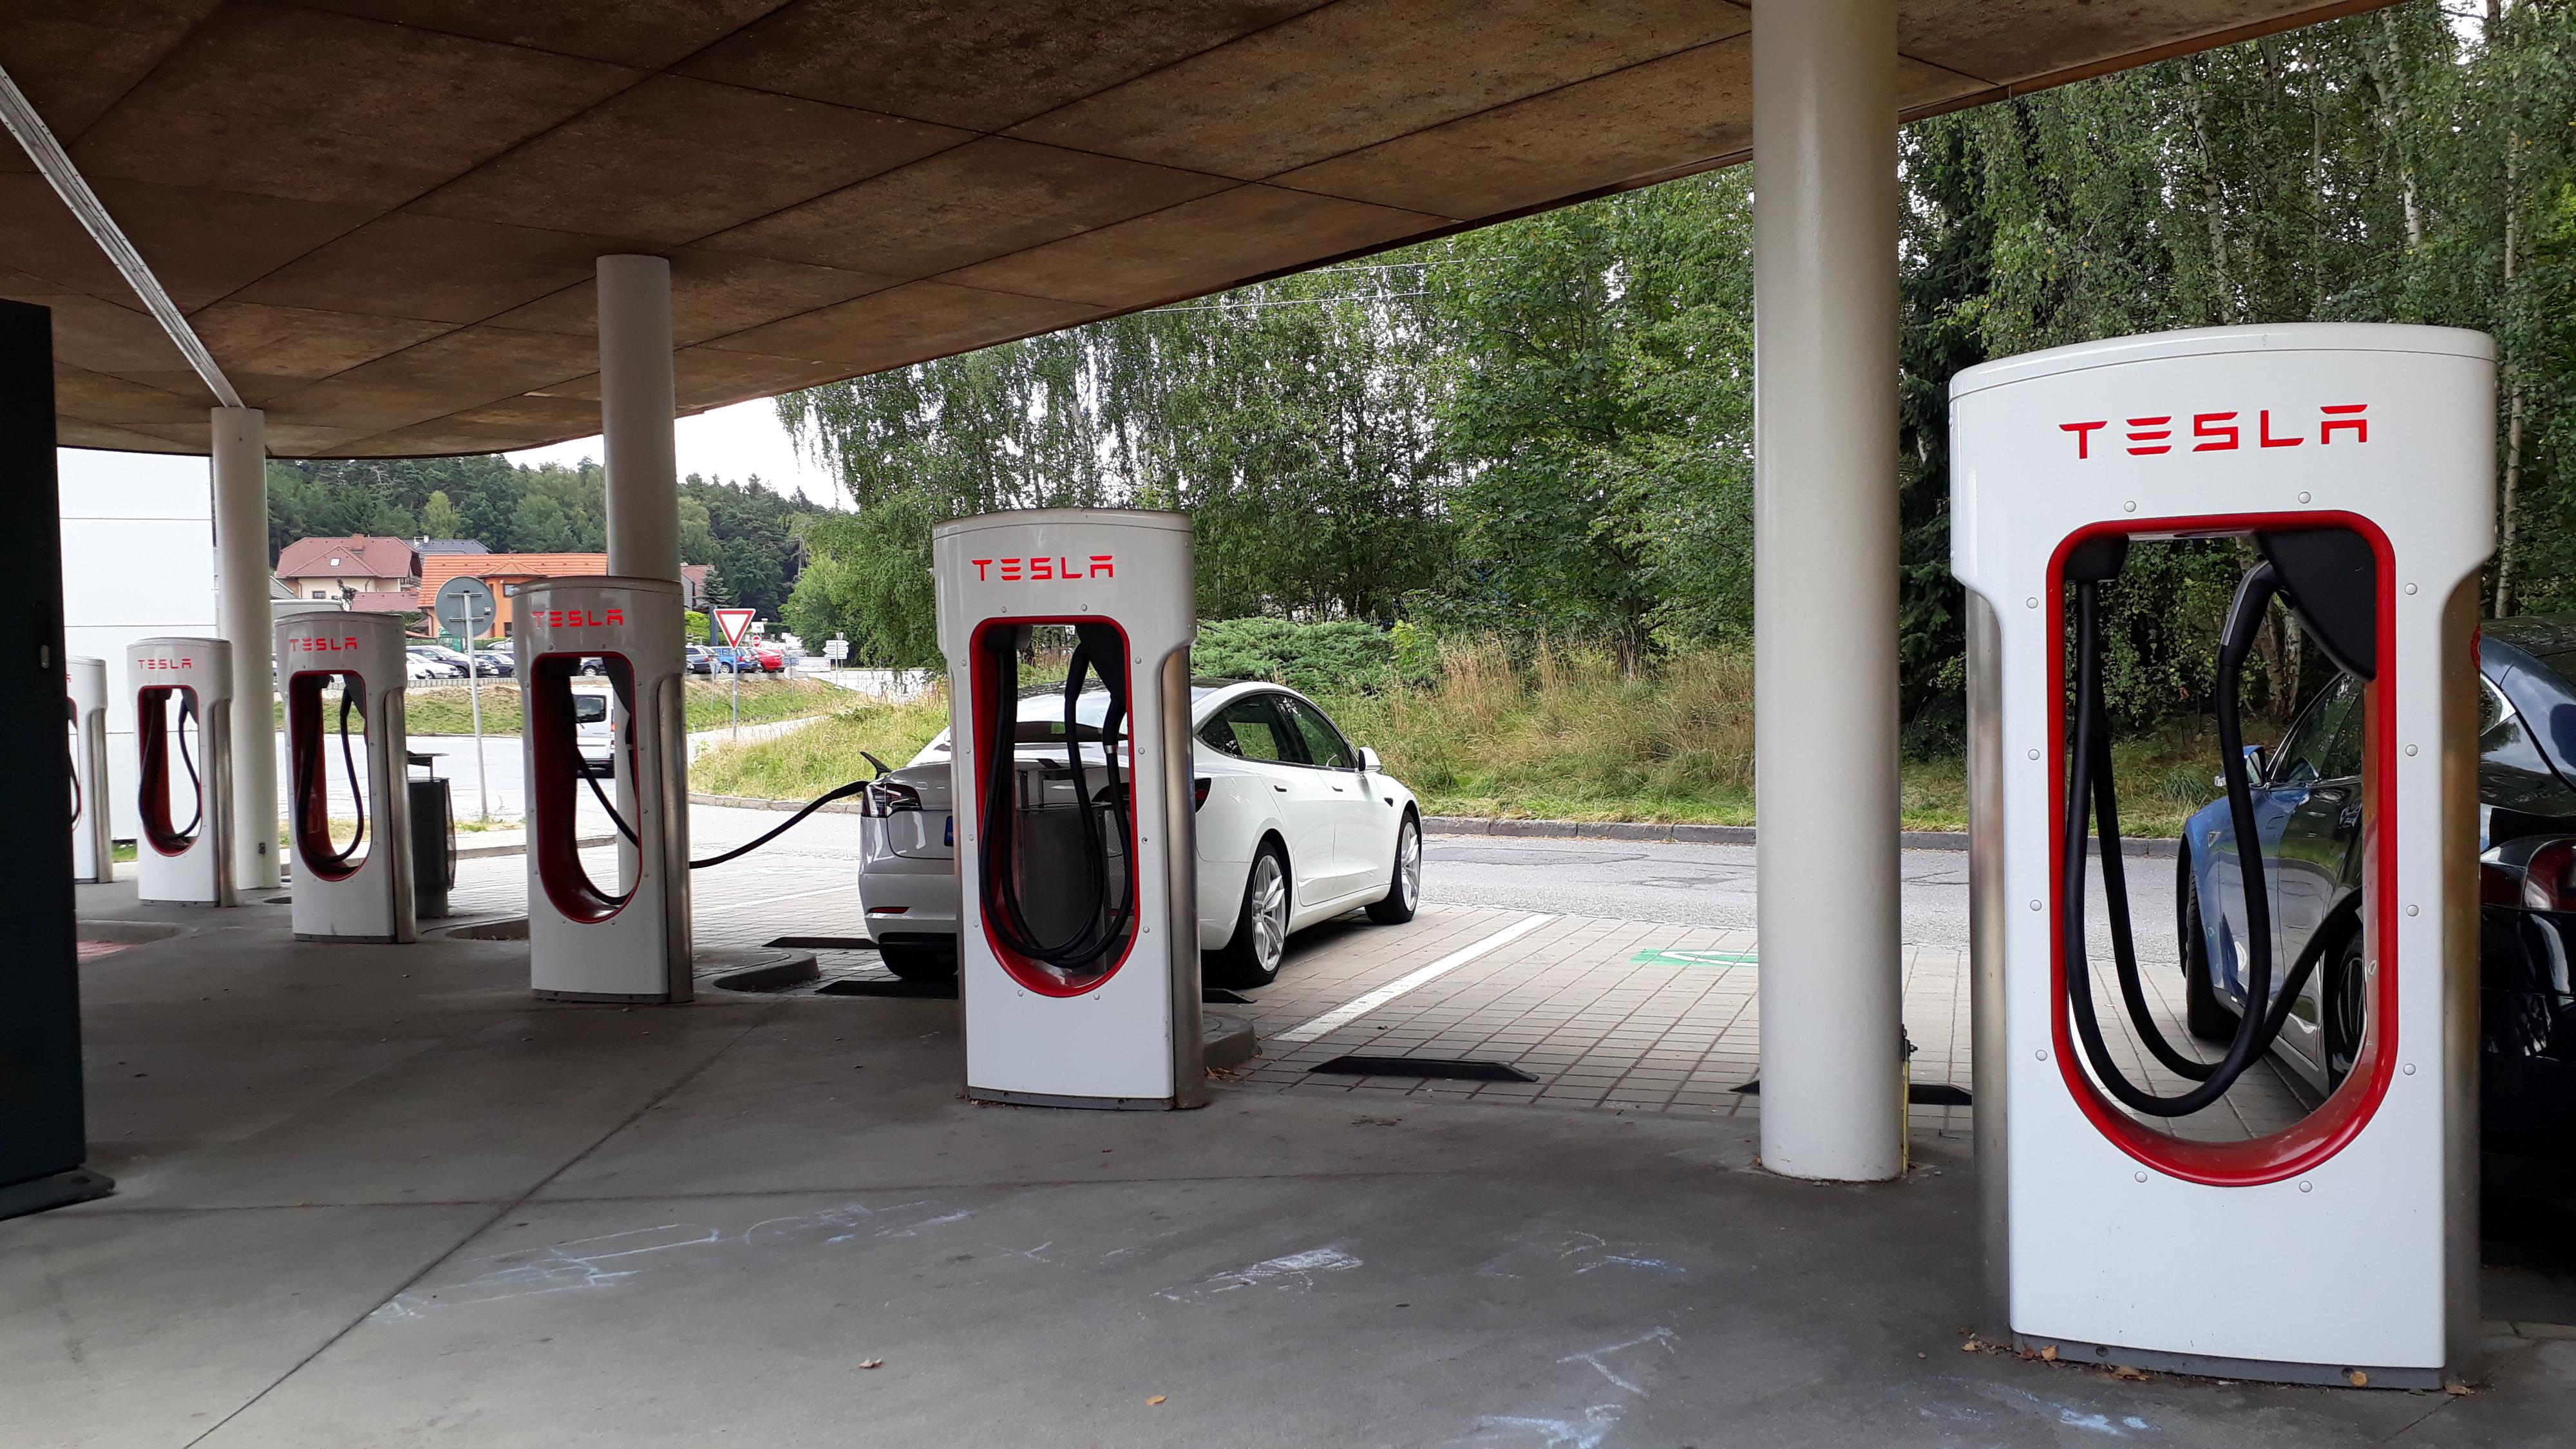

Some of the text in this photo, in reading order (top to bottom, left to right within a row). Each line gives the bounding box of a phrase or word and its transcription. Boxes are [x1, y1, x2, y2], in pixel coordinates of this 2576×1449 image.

[2060, 404, 2369, 460] TESLA
[971, 554, 1114, 582] TESLA
[531, 608, 625, 629] TESLA
[288, 636, 359, 652] TESLA
[137, 658, 193, 670] TESLA
